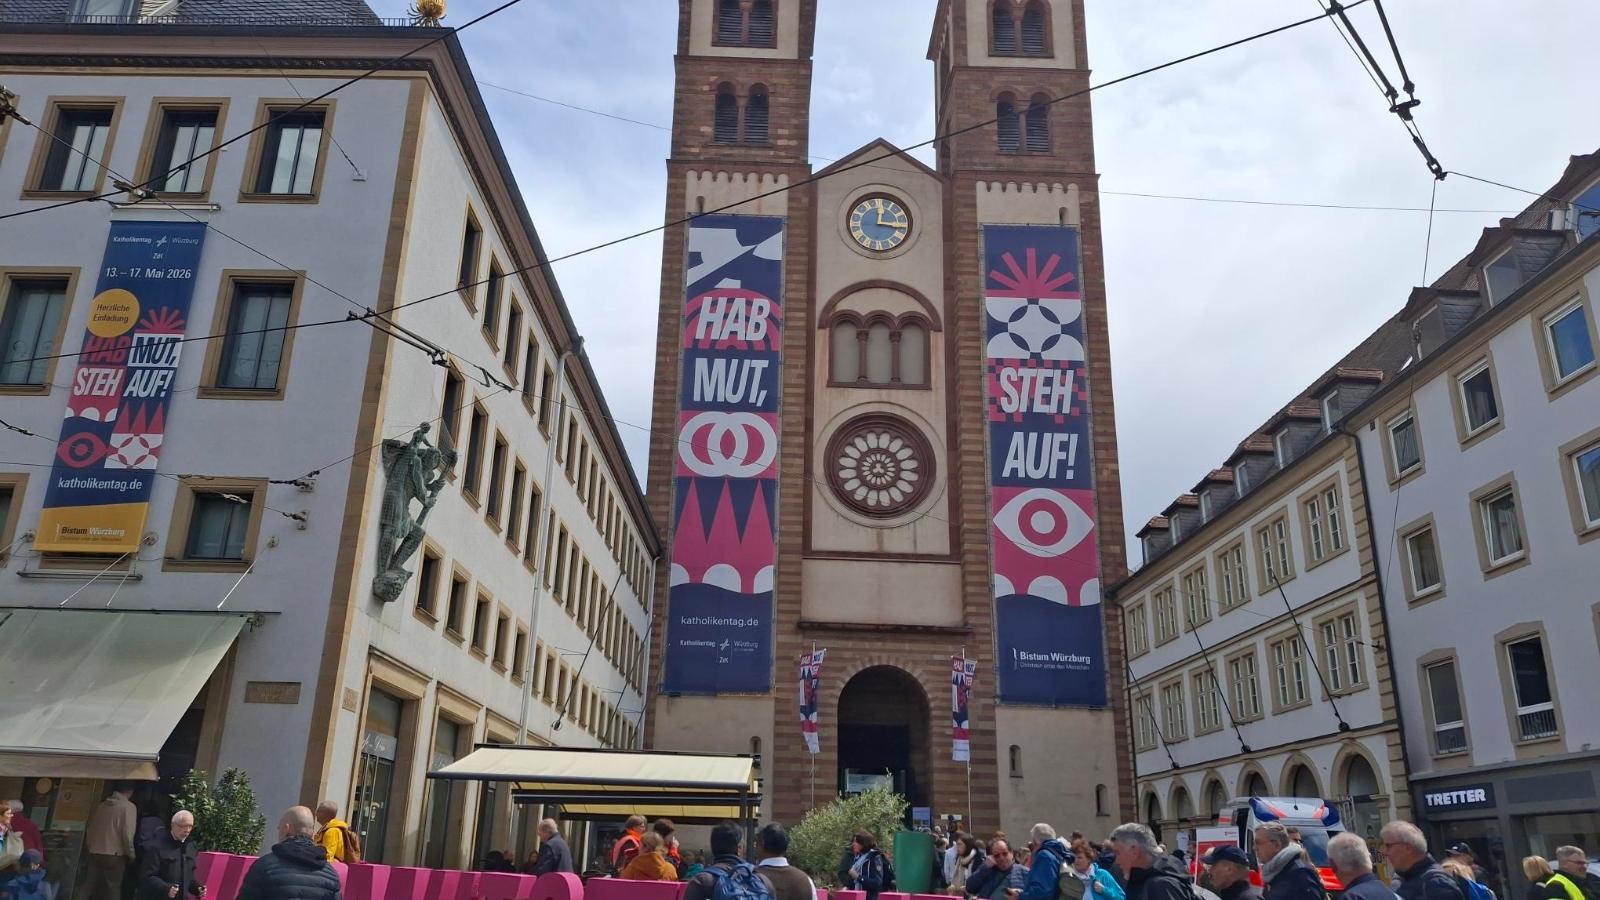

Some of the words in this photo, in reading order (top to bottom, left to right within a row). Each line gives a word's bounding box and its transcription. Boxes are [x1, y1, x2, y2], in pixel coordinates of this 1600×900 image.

[106, 267, 118, 277] 13.
[129, 267, 141, 278] 17.
[145, 268, 164, 278] Mai
[166, 268, 192, 279] 2026
[96, 303, 130, 312] Herzliche
[93, 313, 129, 324] Einladung
[695, 296, 771, 341] HAB
[82, 335, 131, 364] HAB
[131, 336, 181, 365] MUT,
[73, 367, 123, 396] STEH
[123, 369, 174, 397] AUF!
[693, 357, 770, 407] MUT,
[1000, 366, 1075, 414] STEH
[1001, 431, 1079, 480] AUF!
[58, 477, 142, 491] katholikentag.de
[61, 526, 88, 535] Bistum
[89, 527, 125, 537] Würzburg
[681, 616, 759, 628] katholikentag.de
[1020, 651, 1049, 661] Bistum
[1050, 652, 1091, 665] Würzburg
[1425, 788, 1487, 807] TRETTER
